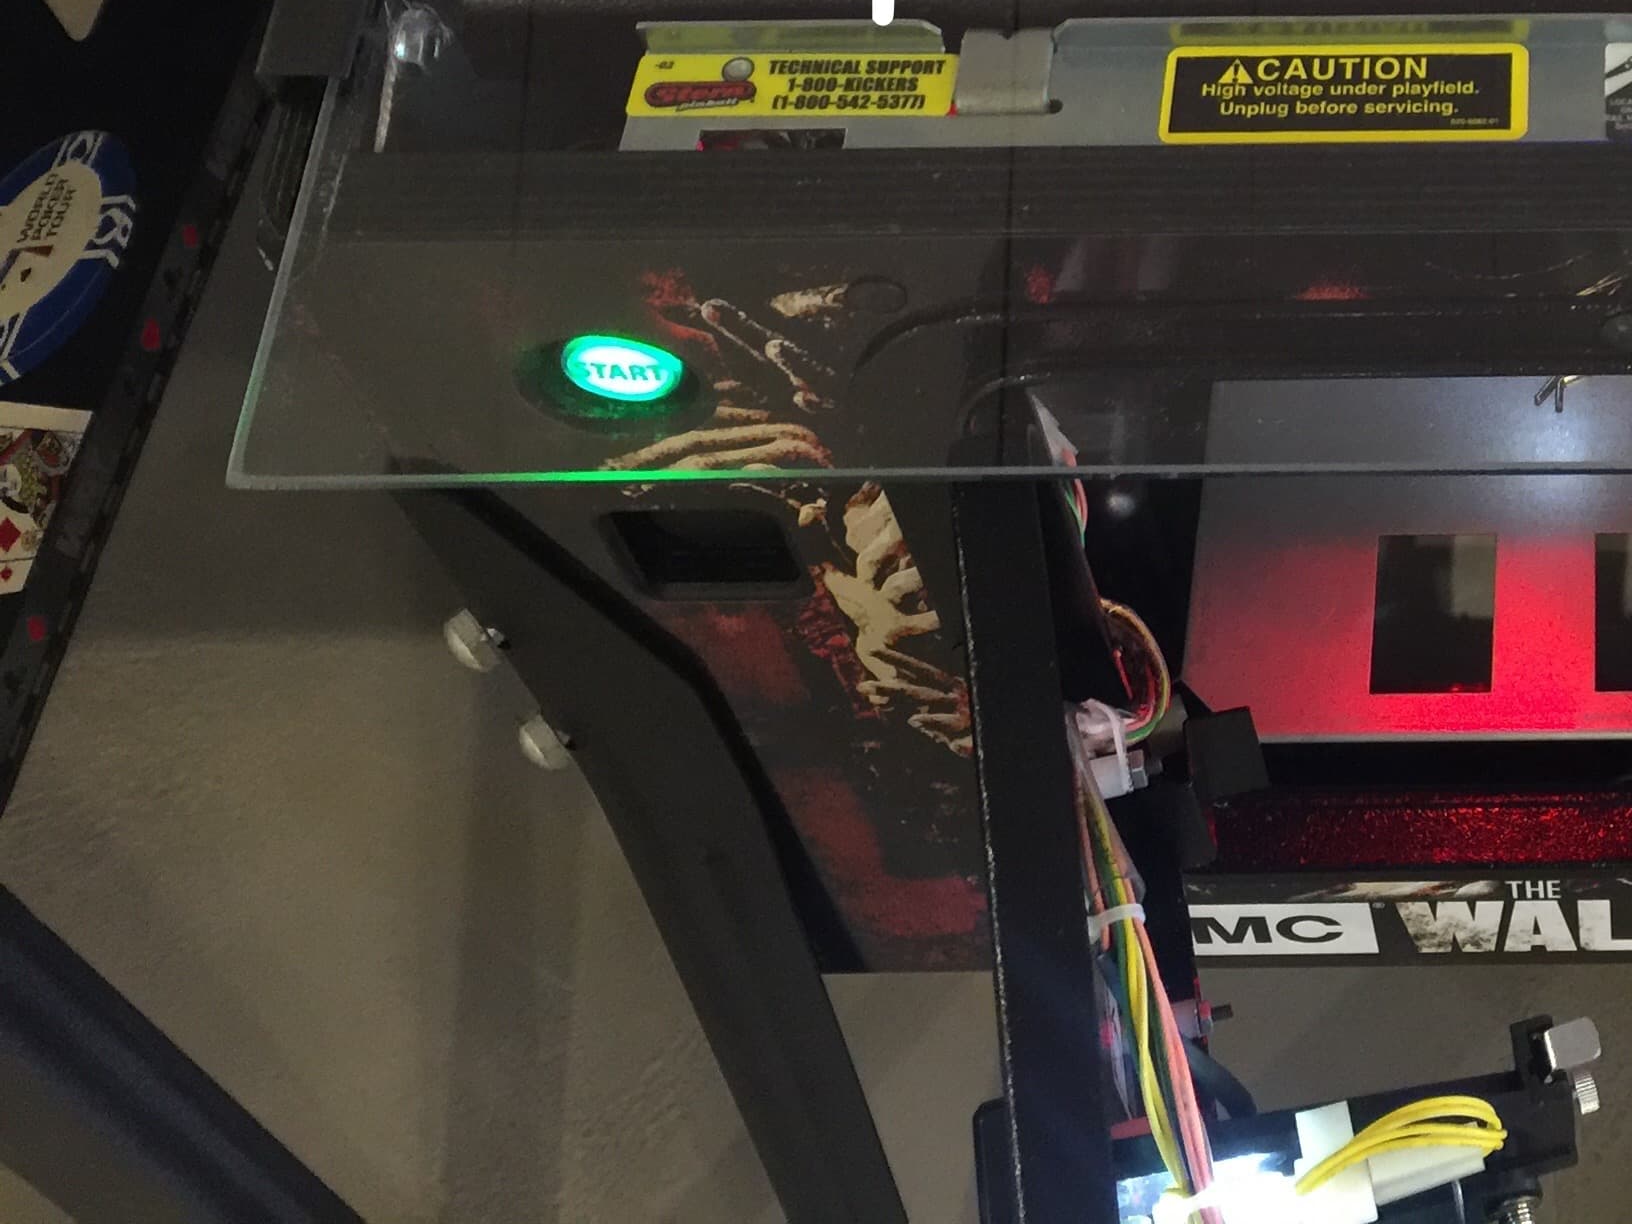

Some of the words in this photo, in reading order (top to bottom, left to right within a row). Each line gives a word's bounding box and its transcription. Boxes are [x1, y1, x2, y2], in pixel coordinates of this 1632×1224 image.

[768, 59, 862, 75] TECHNICAL
[865, 59, 946, 75] SUPPORT
[1257, 57, 1428, 82] CAUTION
[788, 77, 919, 92] 1-800-KICKERS
[1202, 81, 1246, 98] High
[1253, 81, 1324, 97] voltage
[1330, 81, 1385, 96] under
[1392, 80, 1479, 98] playfield.
[772, 94, 926, 110] (1-800-542-5377)
[1220, 102, 1289, 118] Unplug
[1296, 100, 1357, 115] before
[1364, 100, 1459, 117] servicing.
[573, 360, 667, 384] START
[1505, 880, 1562, 899] THE
[1192, 915, 1343, 944] MC
